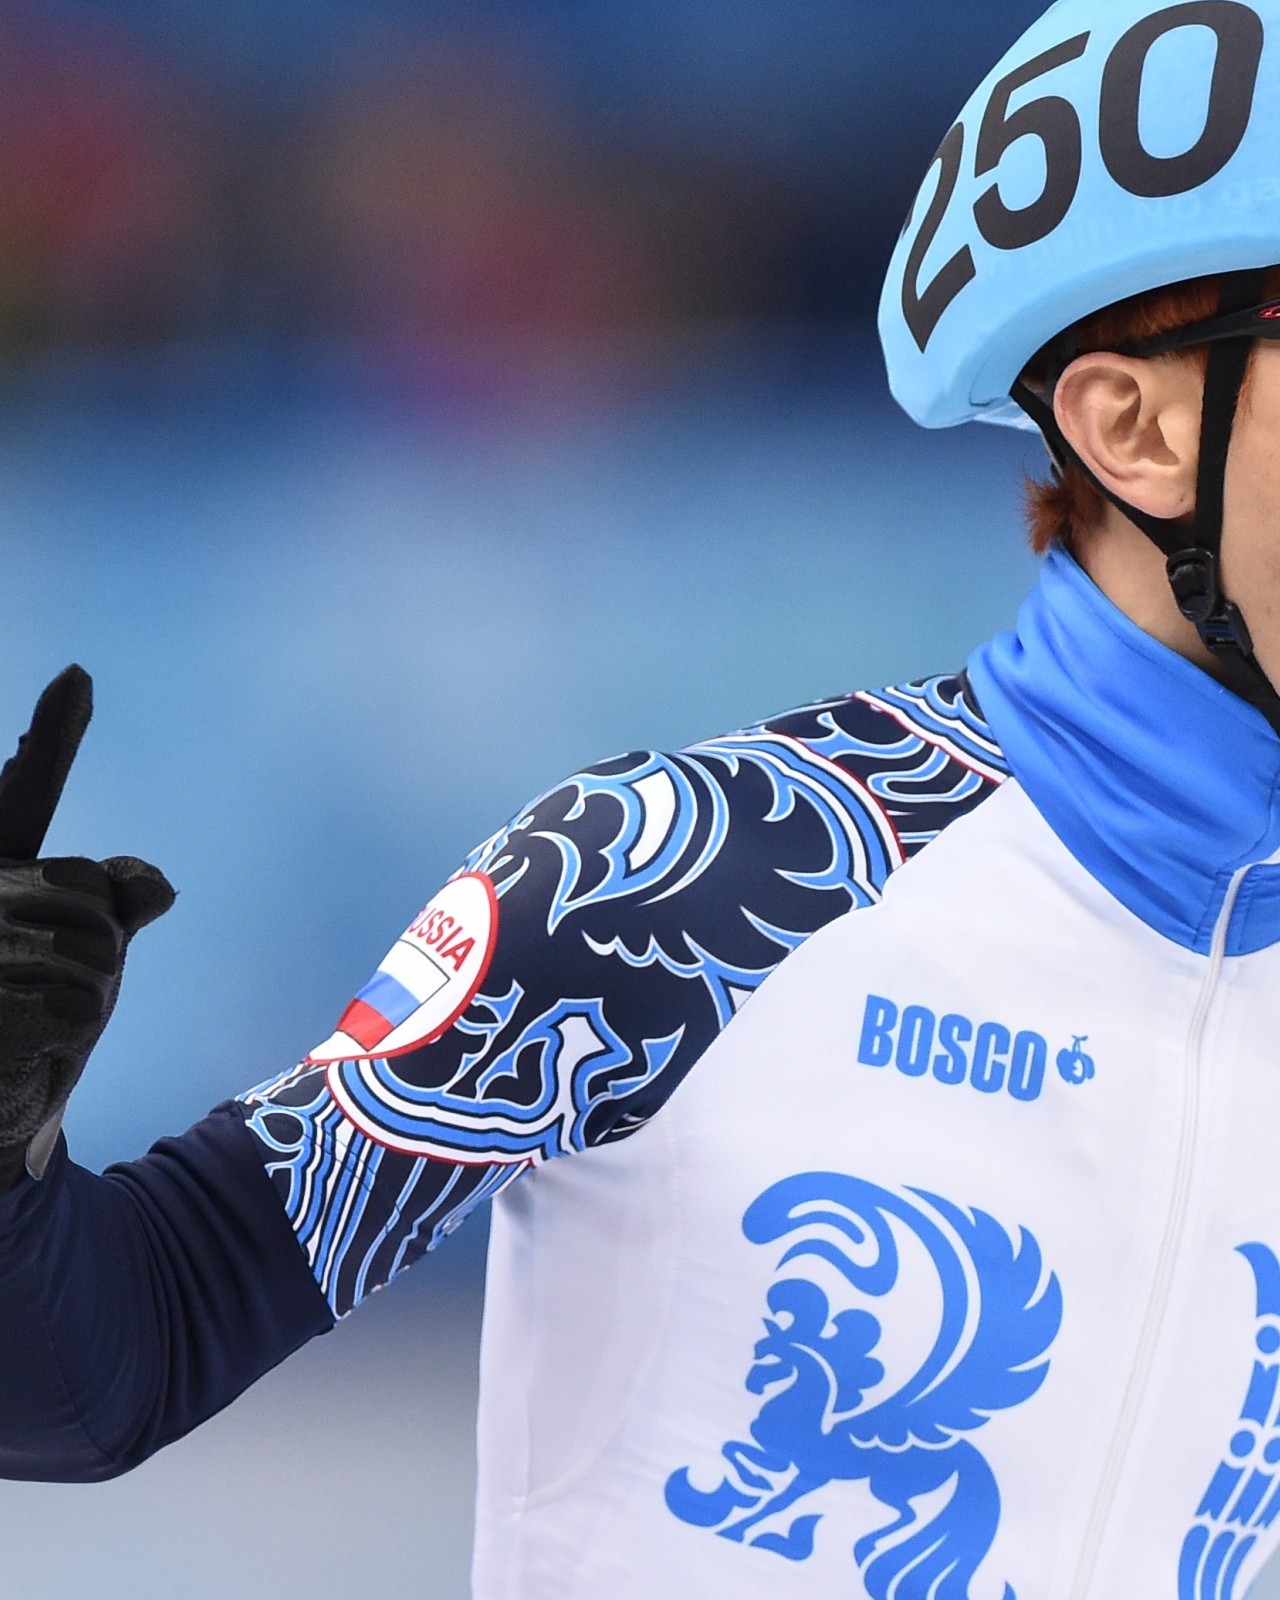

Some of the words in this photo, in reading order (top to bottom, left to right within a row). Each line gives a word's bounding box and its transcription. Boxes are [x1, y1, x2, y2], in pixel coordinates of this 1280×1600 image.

[902, 0, 1264, 353] 250
[407, 905, 476, 974] USSIA
[856, 993, 1047, 1102] BOSCO
